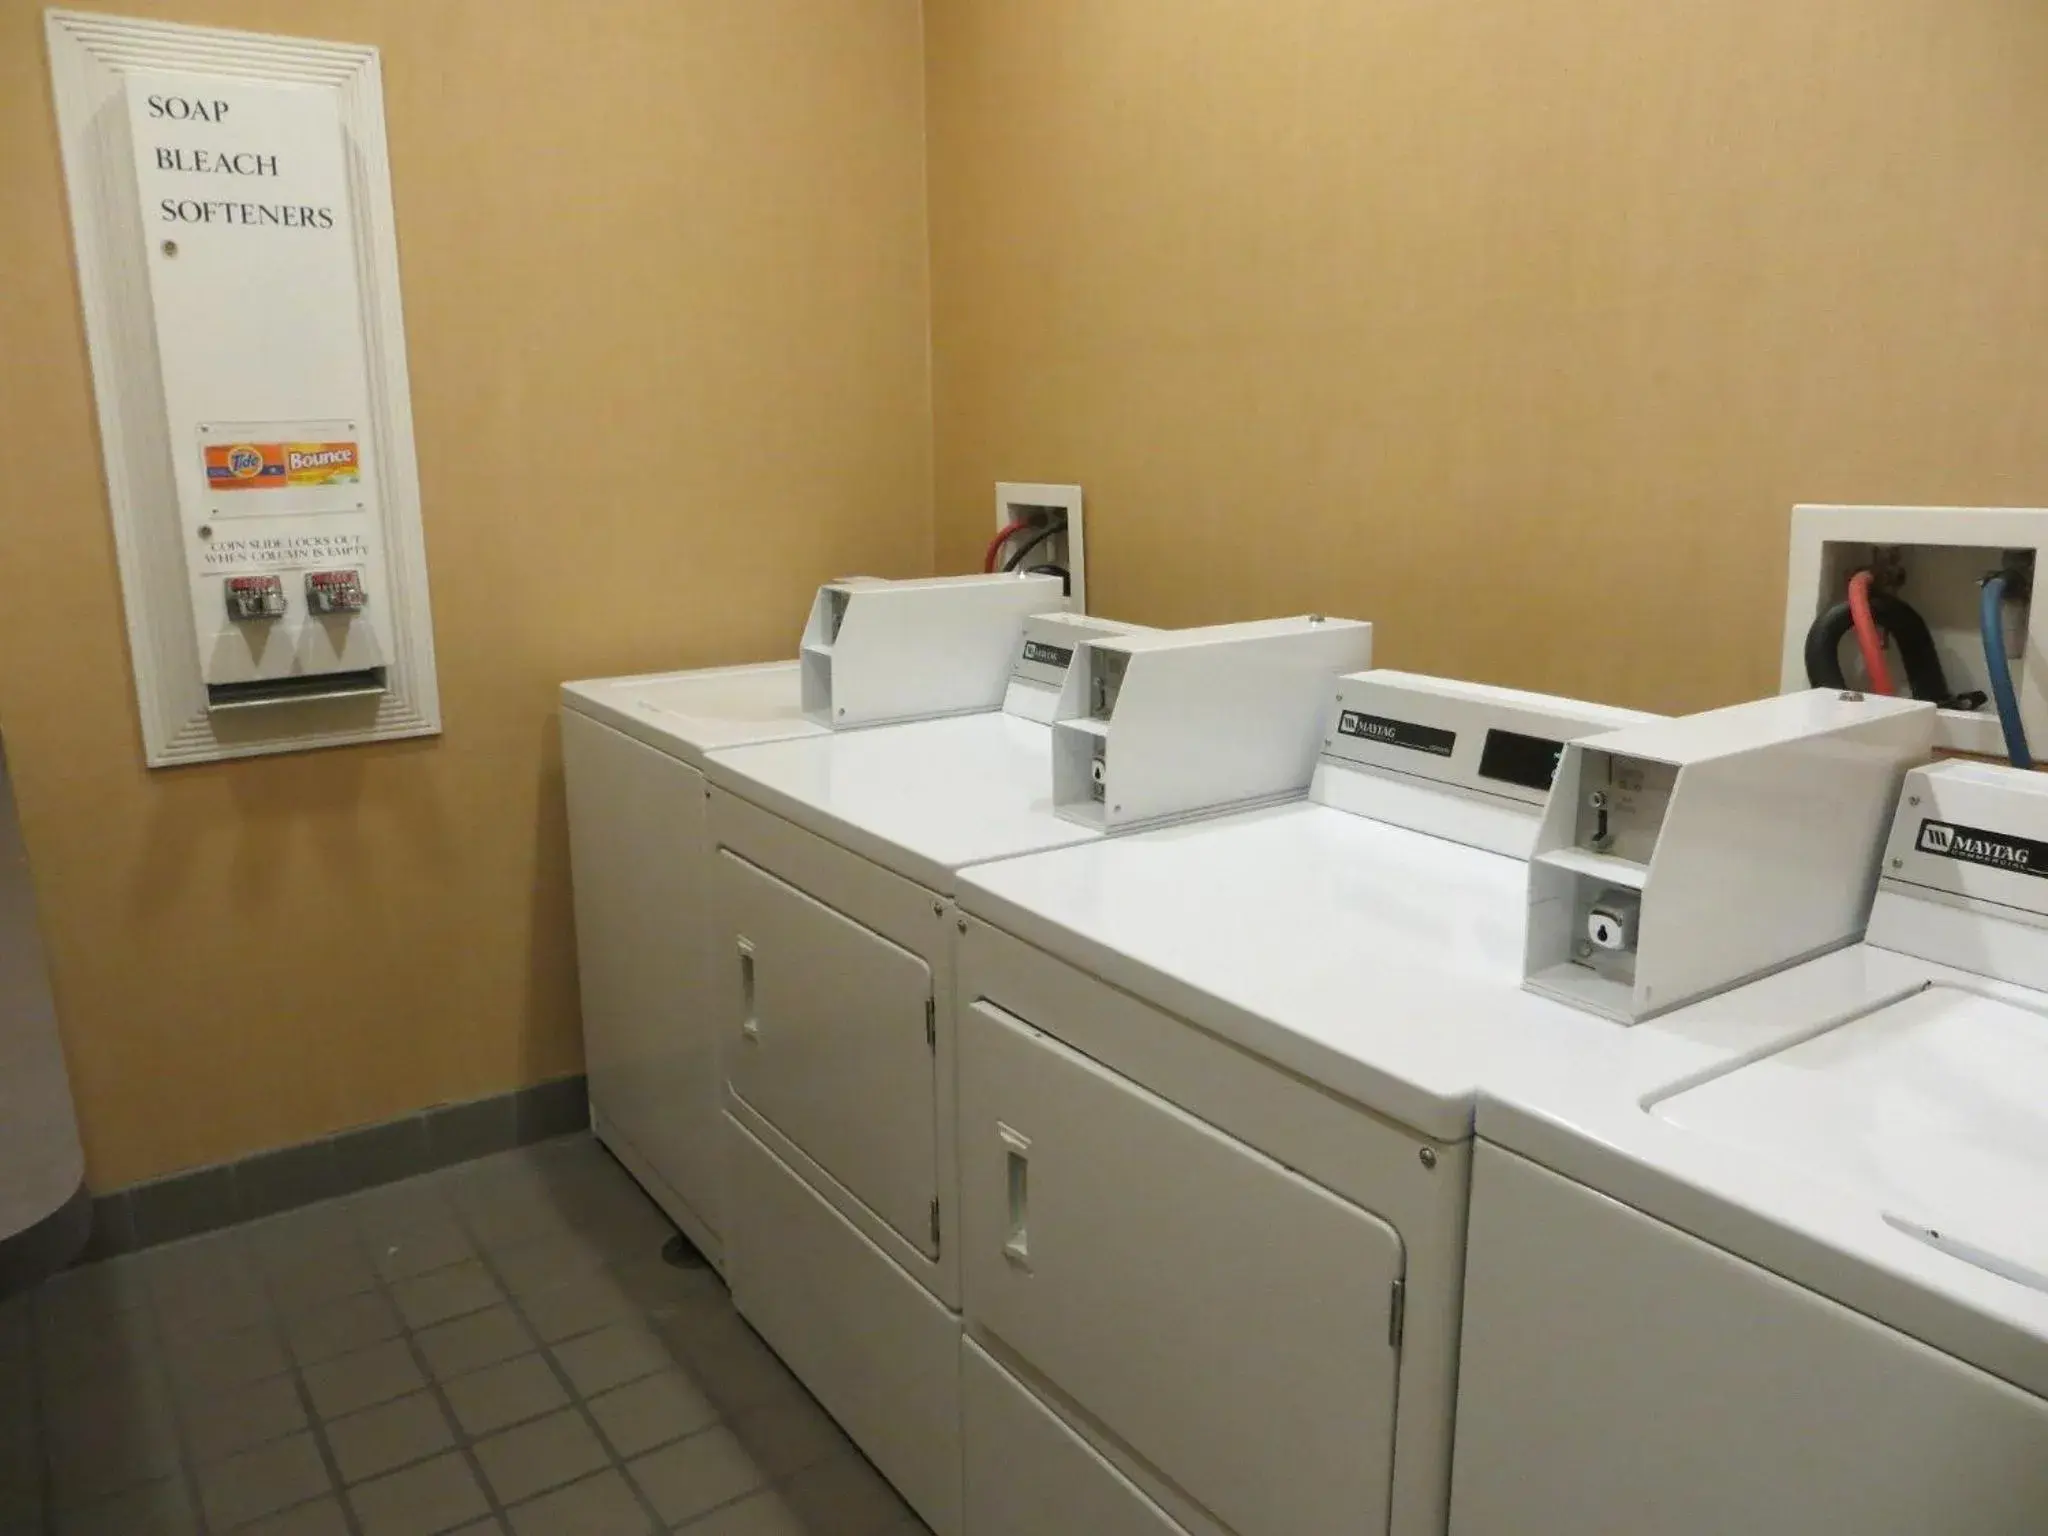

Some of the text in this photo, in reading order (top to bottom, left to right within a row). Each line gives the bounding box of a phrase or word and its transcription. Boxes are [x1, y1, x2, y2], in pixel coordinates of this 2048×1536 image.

[147, 95, 229, 122] SOAP
[155, 147, 279, 176] BLEACH
[160, 199, 334, 229] SOFTENERS
[231, 451, 259, 470] Tide
[289, 448, 353, 470] Bounce
[209, 541, 245, 551] COIN
[1359, 721, 1397, 738] MAYTAG
[1953, 836, 2030, 864] MAYTAG
